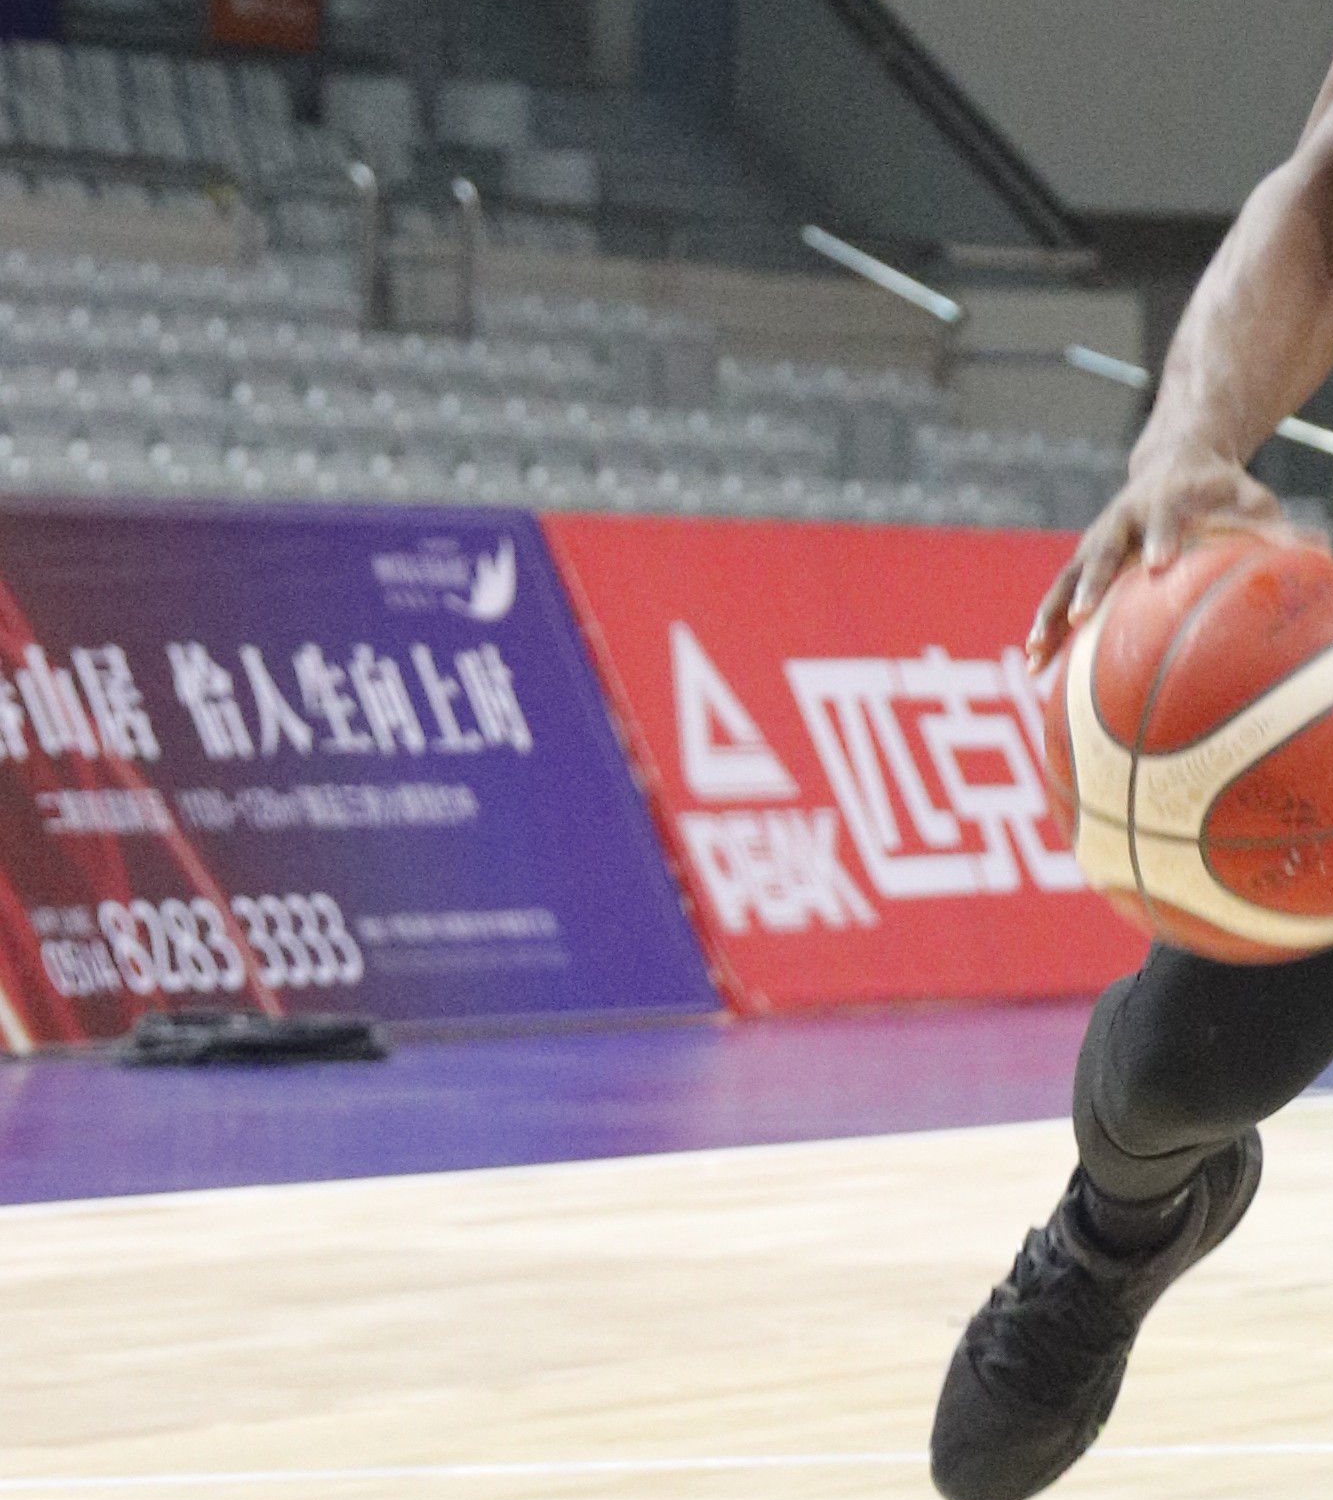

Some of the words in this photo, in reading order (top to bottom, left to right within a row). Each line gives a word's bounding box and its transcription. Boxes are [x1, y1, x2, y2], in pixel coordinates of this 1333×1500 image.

[676, 806, 880, 933] PEAK
[98, 898, 246, 994] 8283
[232, 892, 364, 986] 3333
